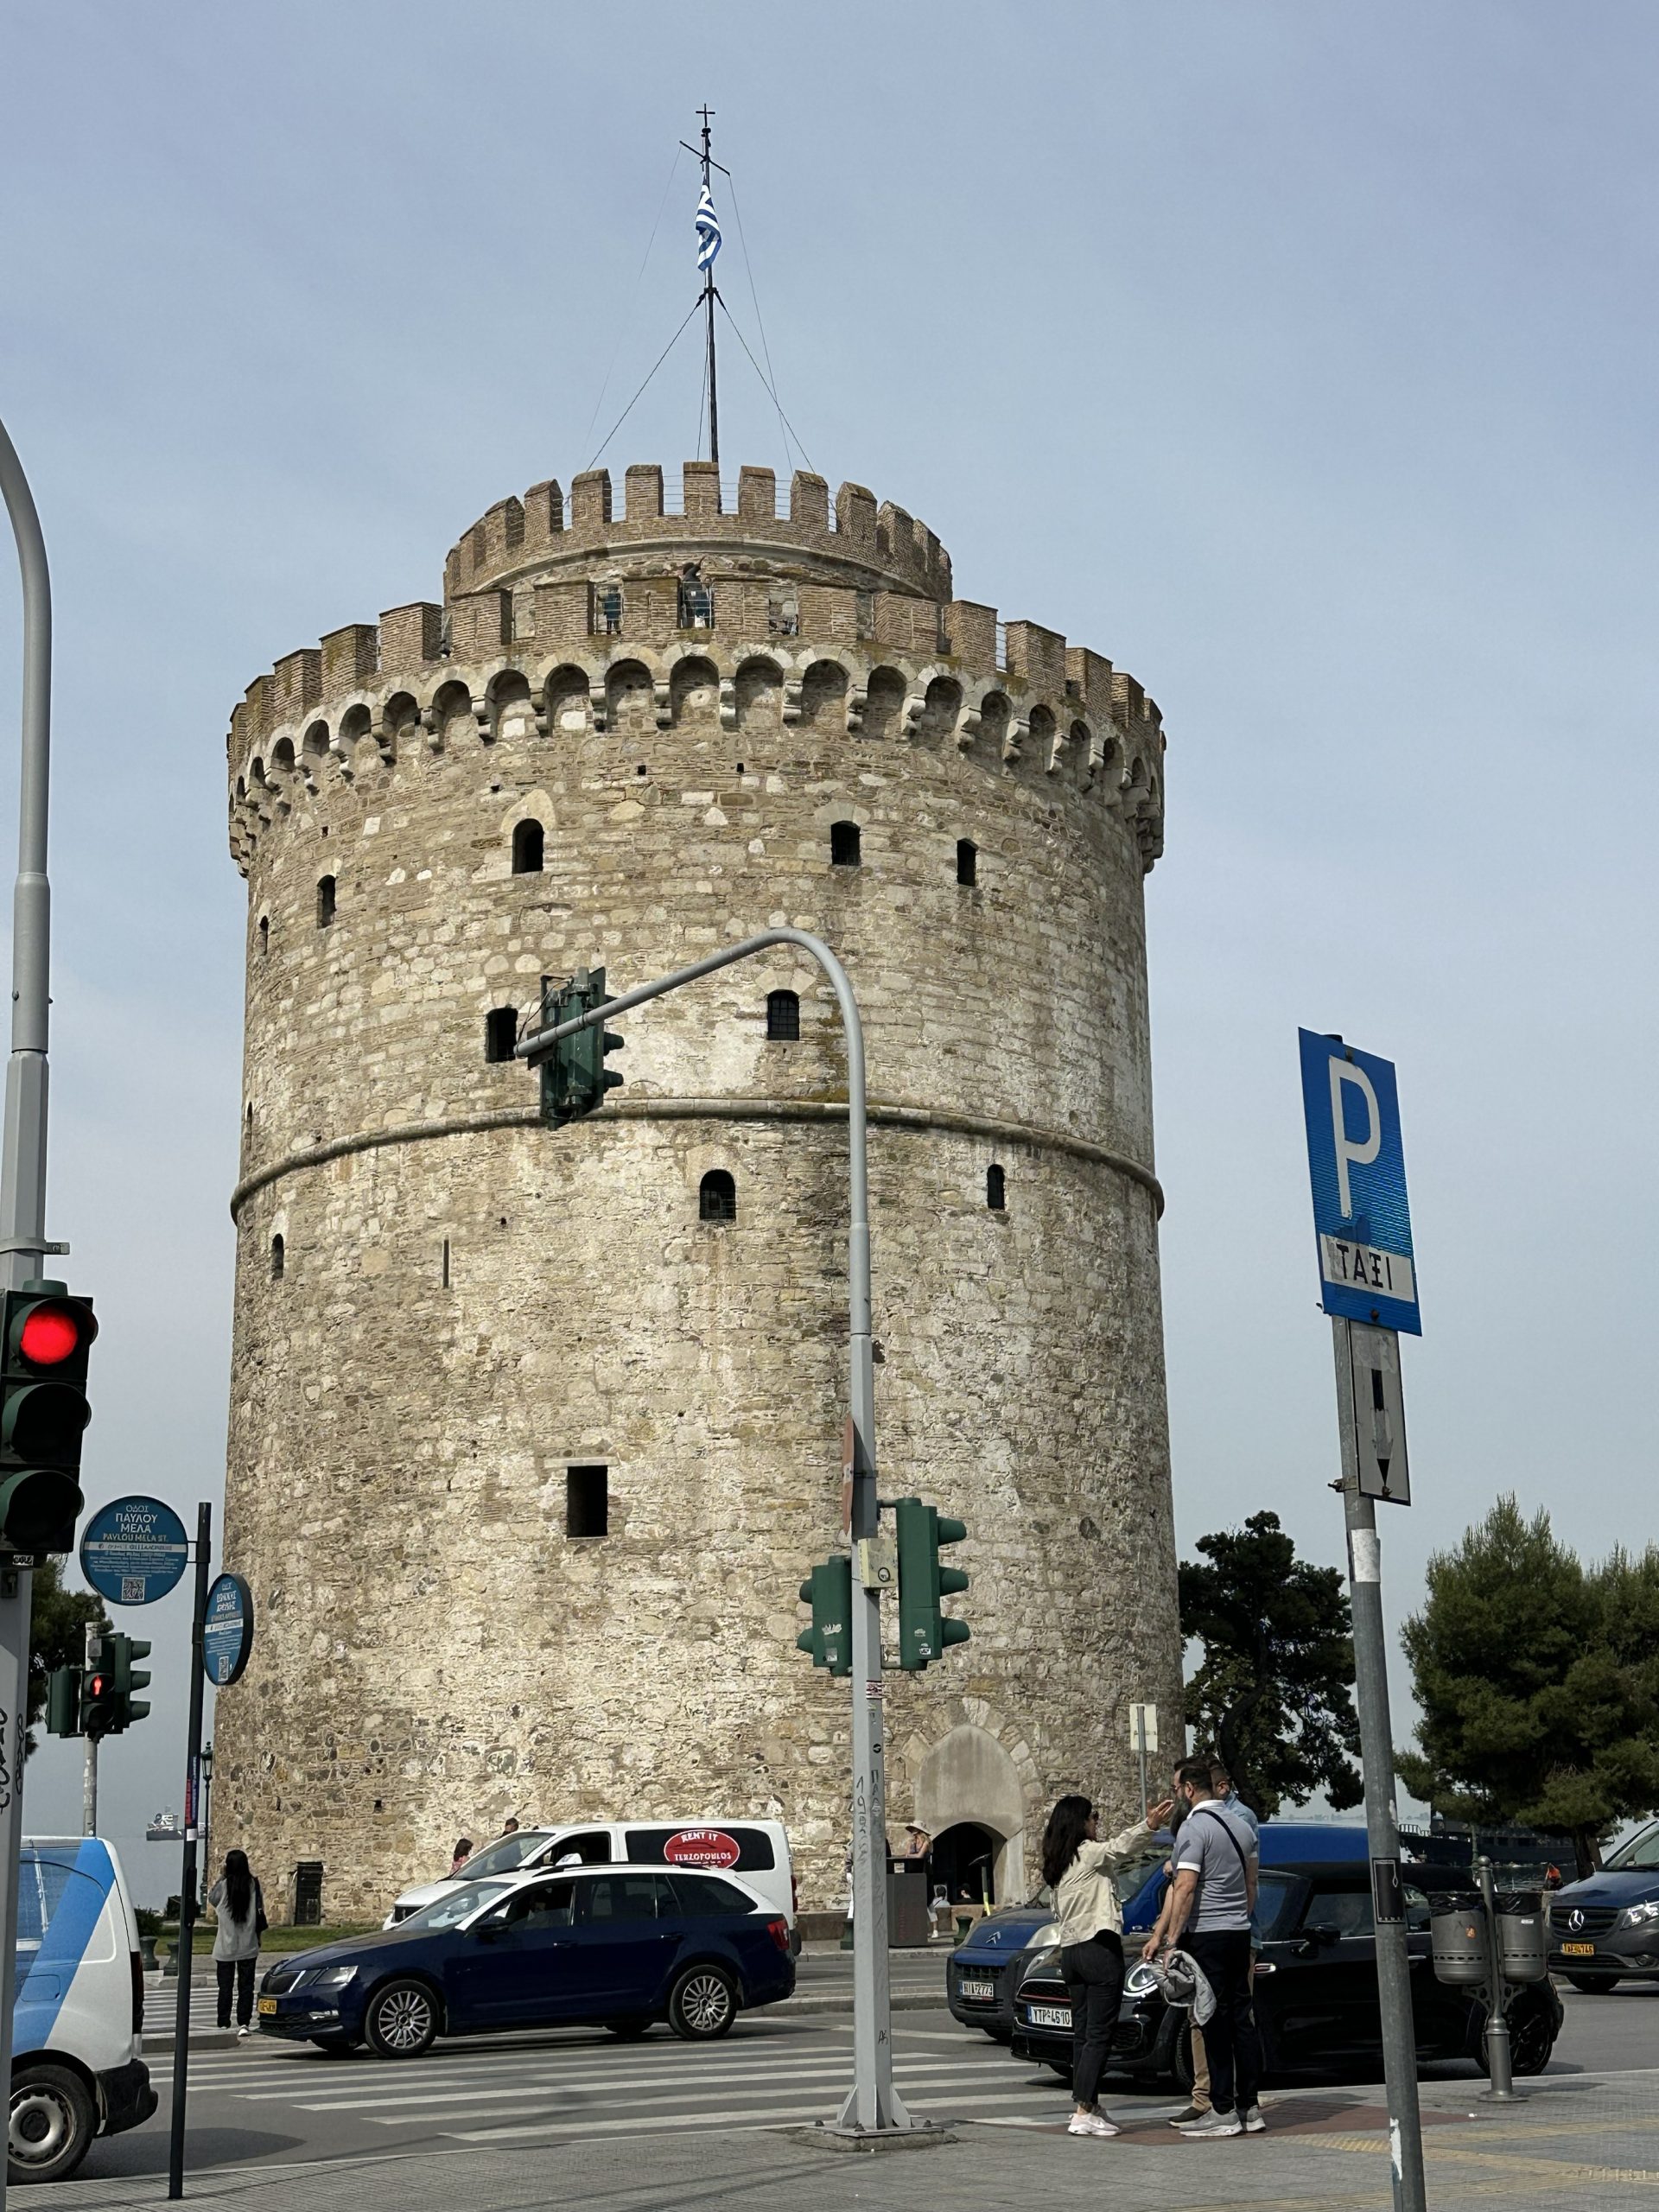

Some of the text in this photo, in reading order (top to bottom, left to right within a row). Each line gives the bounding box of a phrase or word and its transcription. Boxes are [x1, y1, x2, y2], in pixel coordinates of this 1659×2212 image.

[1329, 1055, 1381, 1219] P
[115, 1513, 158, 1523] ΠΑΥΛΟΥ
[120, 1523, 151, 1533] ΜΕΛΑ
[103, 1533, 133, 1541] PAVLOU
[680, 1832, 719, 1842] RENT IT
